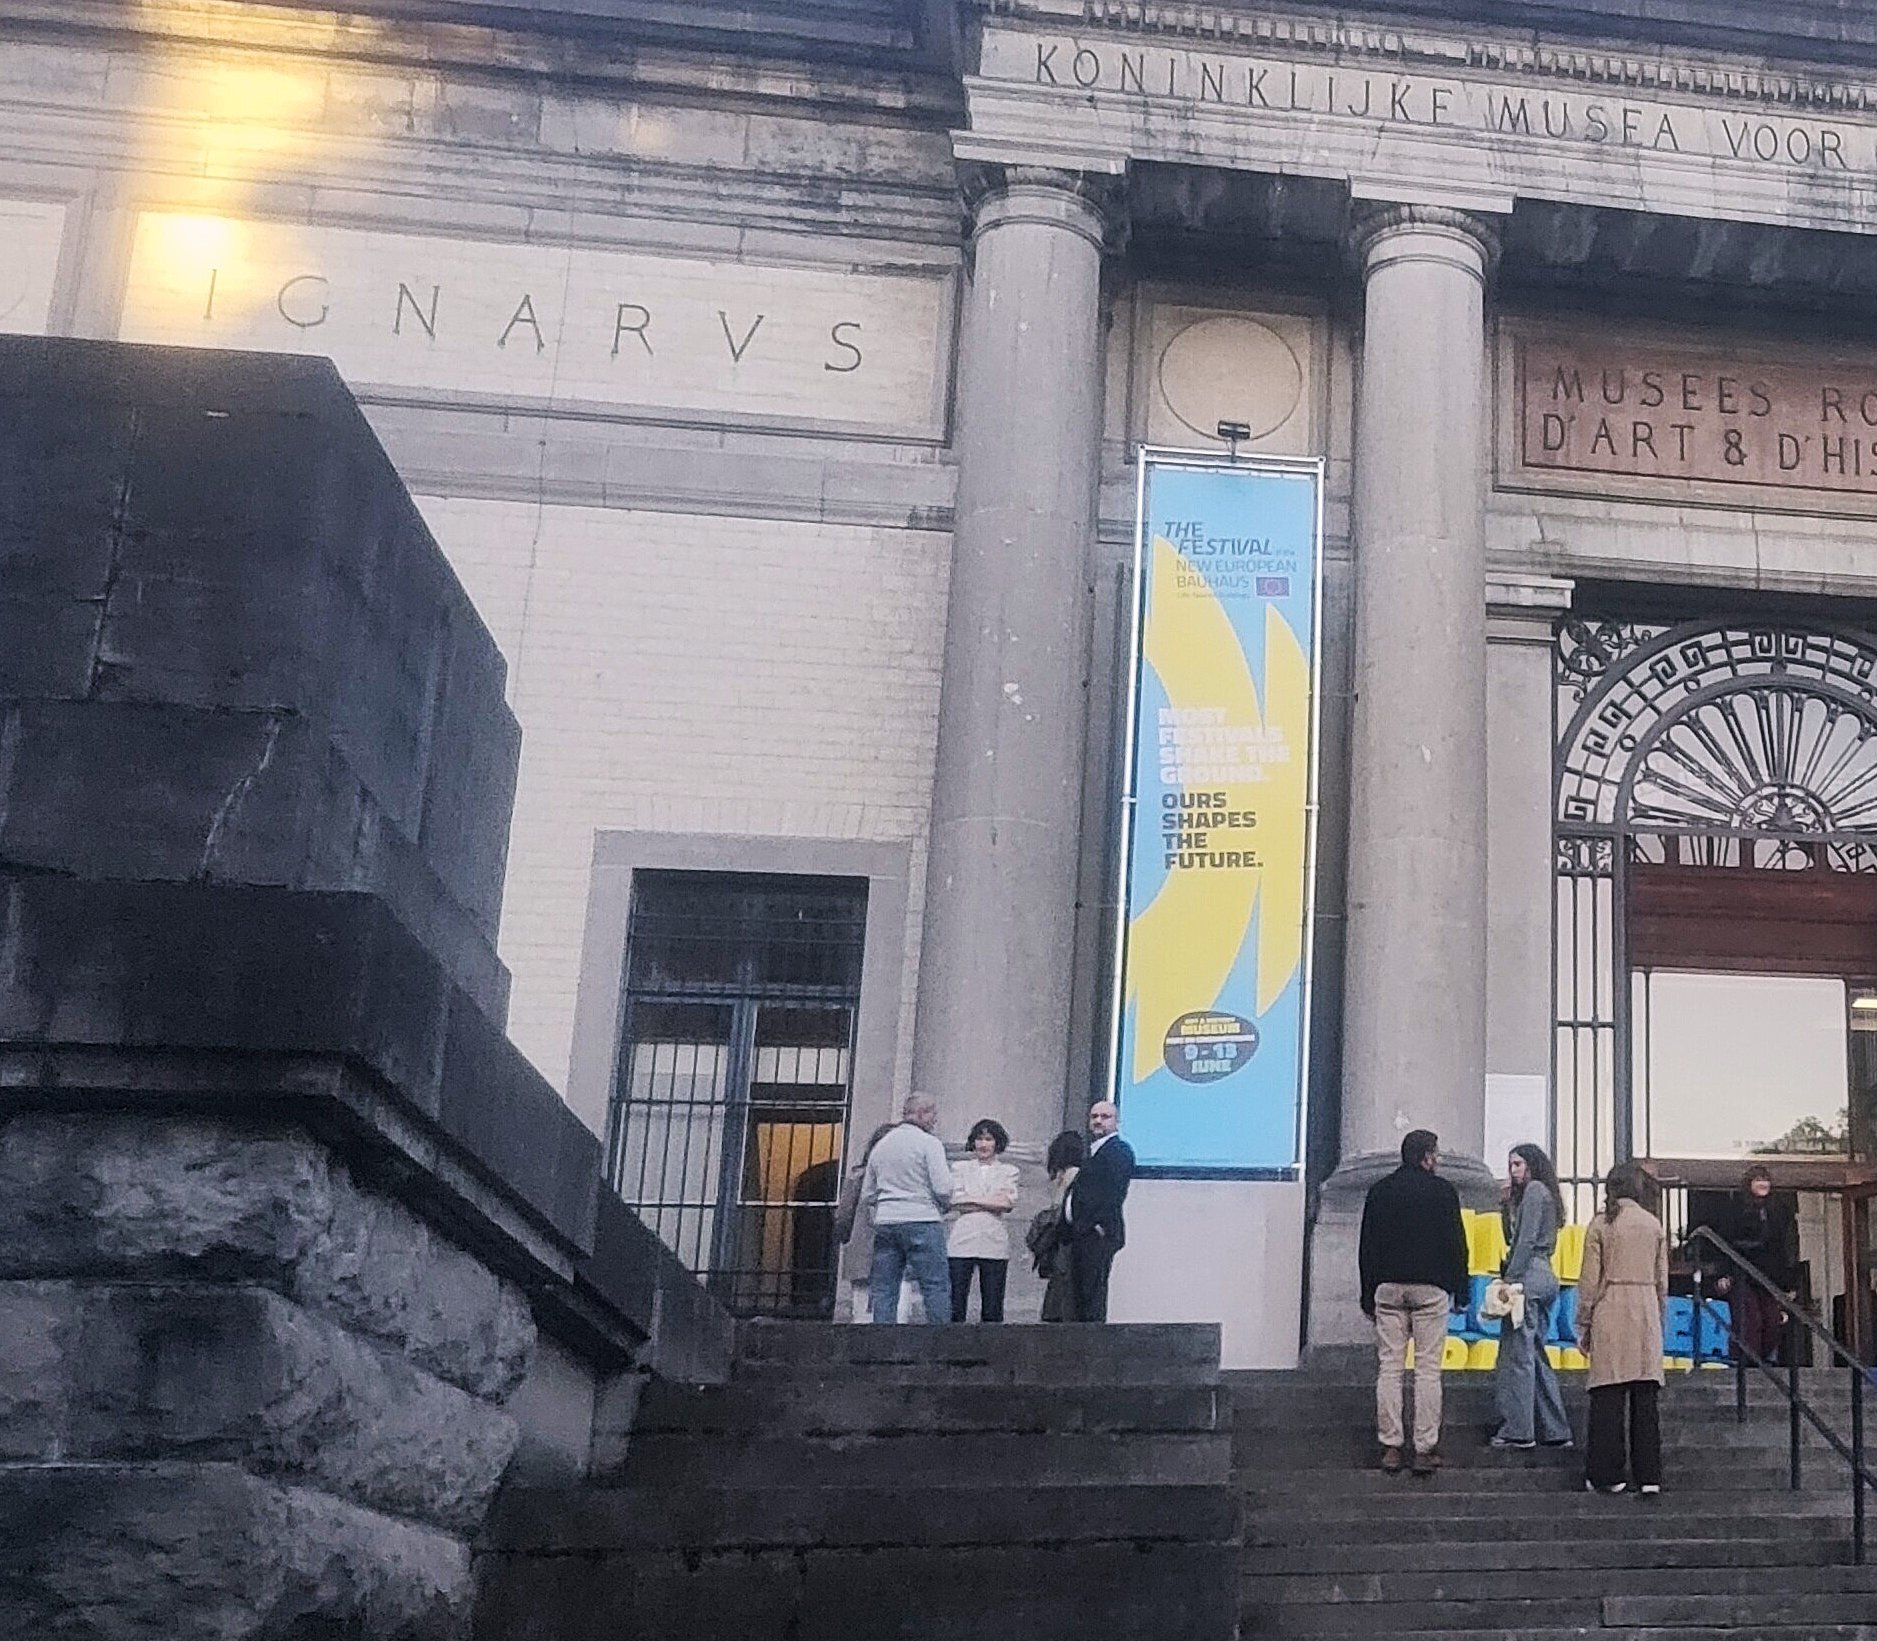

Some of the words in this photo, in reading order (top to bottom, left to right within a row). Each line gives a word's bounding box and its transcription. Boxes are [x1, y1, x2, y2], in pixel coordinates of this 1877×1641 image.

[1036, 44, 1453, 125] KONINKLIJKE
[1499, 95, 1680, 151] MUSEA
[1721, 118, 1849, 169] VOOR
[204, 268, 863, 373] IGNARVS
[1551, 365, 1773, 418] MUSEES
[1542, 413, 1695, 461] D'ART
[1724, 429, 1747, 466] &
[1164, 521, 1204, 538] THE
[1178, 538, 1272, 555] FESTIVAL
[1176, 559, 1211, 573] NEW
[1215, 559, 1297, 573] EUROPEAN
[1176, 575, 1250, 588] BAUHAUS
[1161, 792, 1228, 809] OURS
[1162, 811, 1257, 829] SHAPES
[1162, 832, 1208, 849] THE
[1164, 851, 1264, 869] FUTURE.
